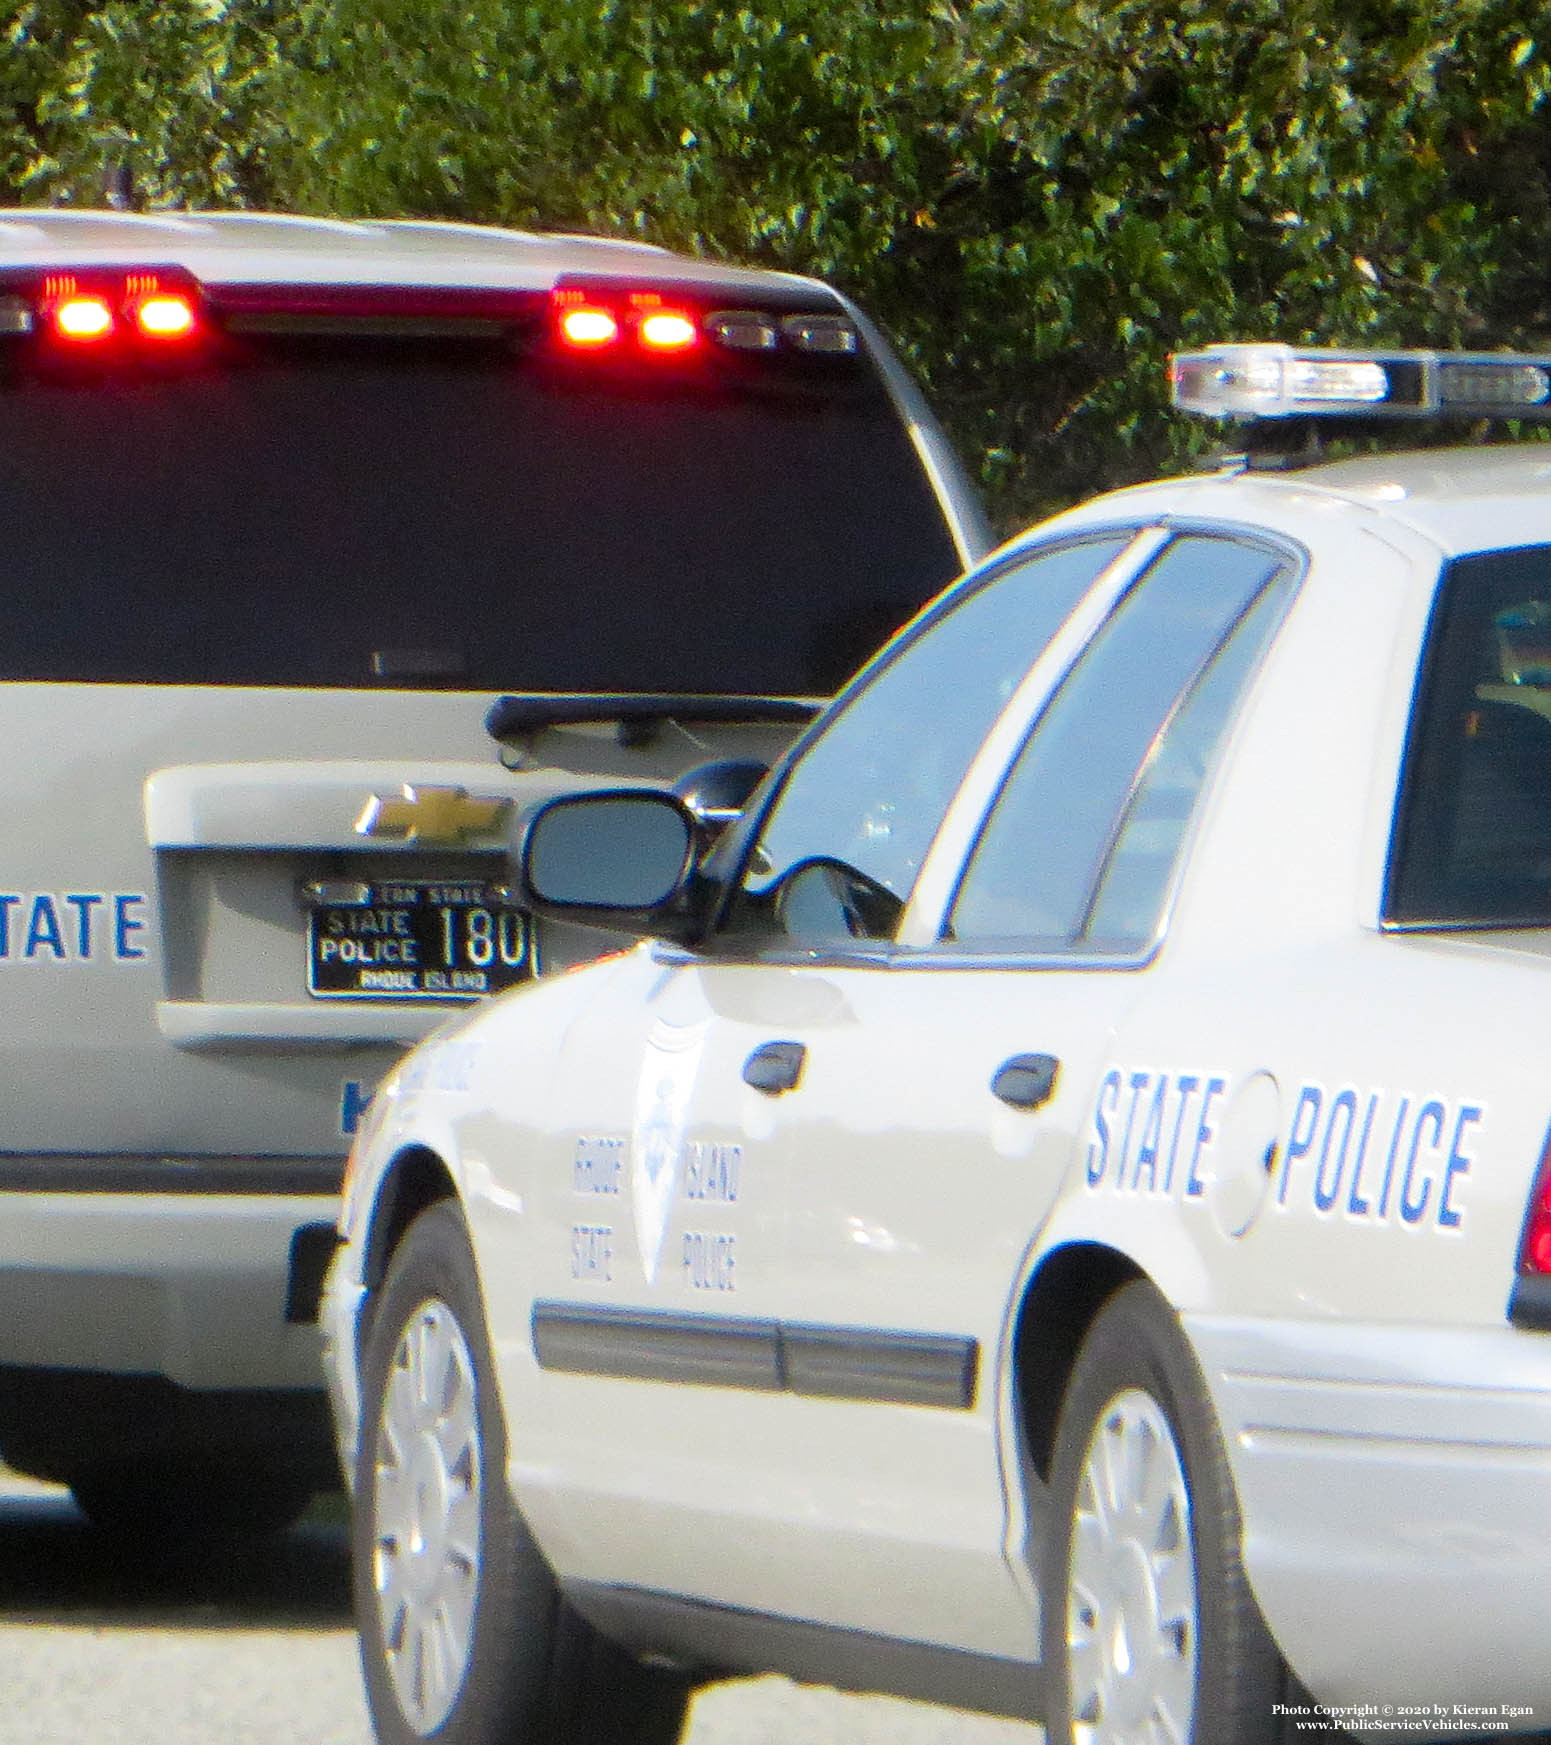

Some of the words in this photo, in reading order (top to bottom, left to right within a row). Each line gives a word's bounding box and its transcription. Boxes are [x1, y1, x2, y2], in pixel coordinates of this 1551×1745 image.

[327, 909, 411, 934] STATE
[440, 907, 526, 967] 180
[319, 938, 418, 963] POLICE
[359, 970, 416, 989] RHODE
[422, 970, 489, 989] ISLAND
[1086, 1070, 1226, 1196] STATE
[1277, 1085, 1482, 1227] POLICE
